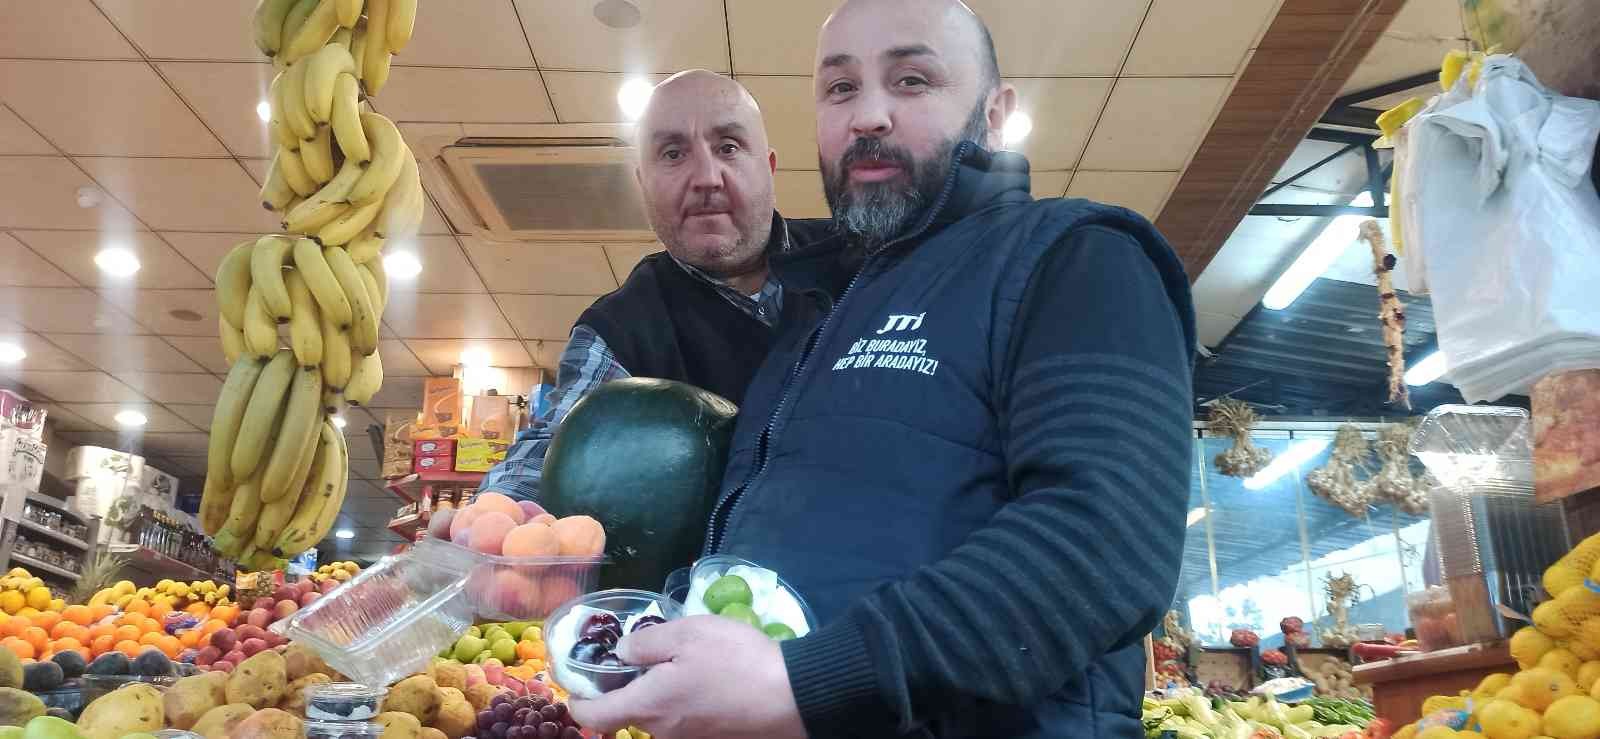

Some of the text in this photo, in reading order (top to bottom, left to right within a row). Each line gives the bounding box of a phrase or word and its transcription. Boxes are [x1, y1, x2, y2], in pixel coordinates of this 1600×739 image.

[848, 338, 866, 355] BİZ
[832, 356, 854, 371] HEP
[854, 352, 874, 368] BİR
